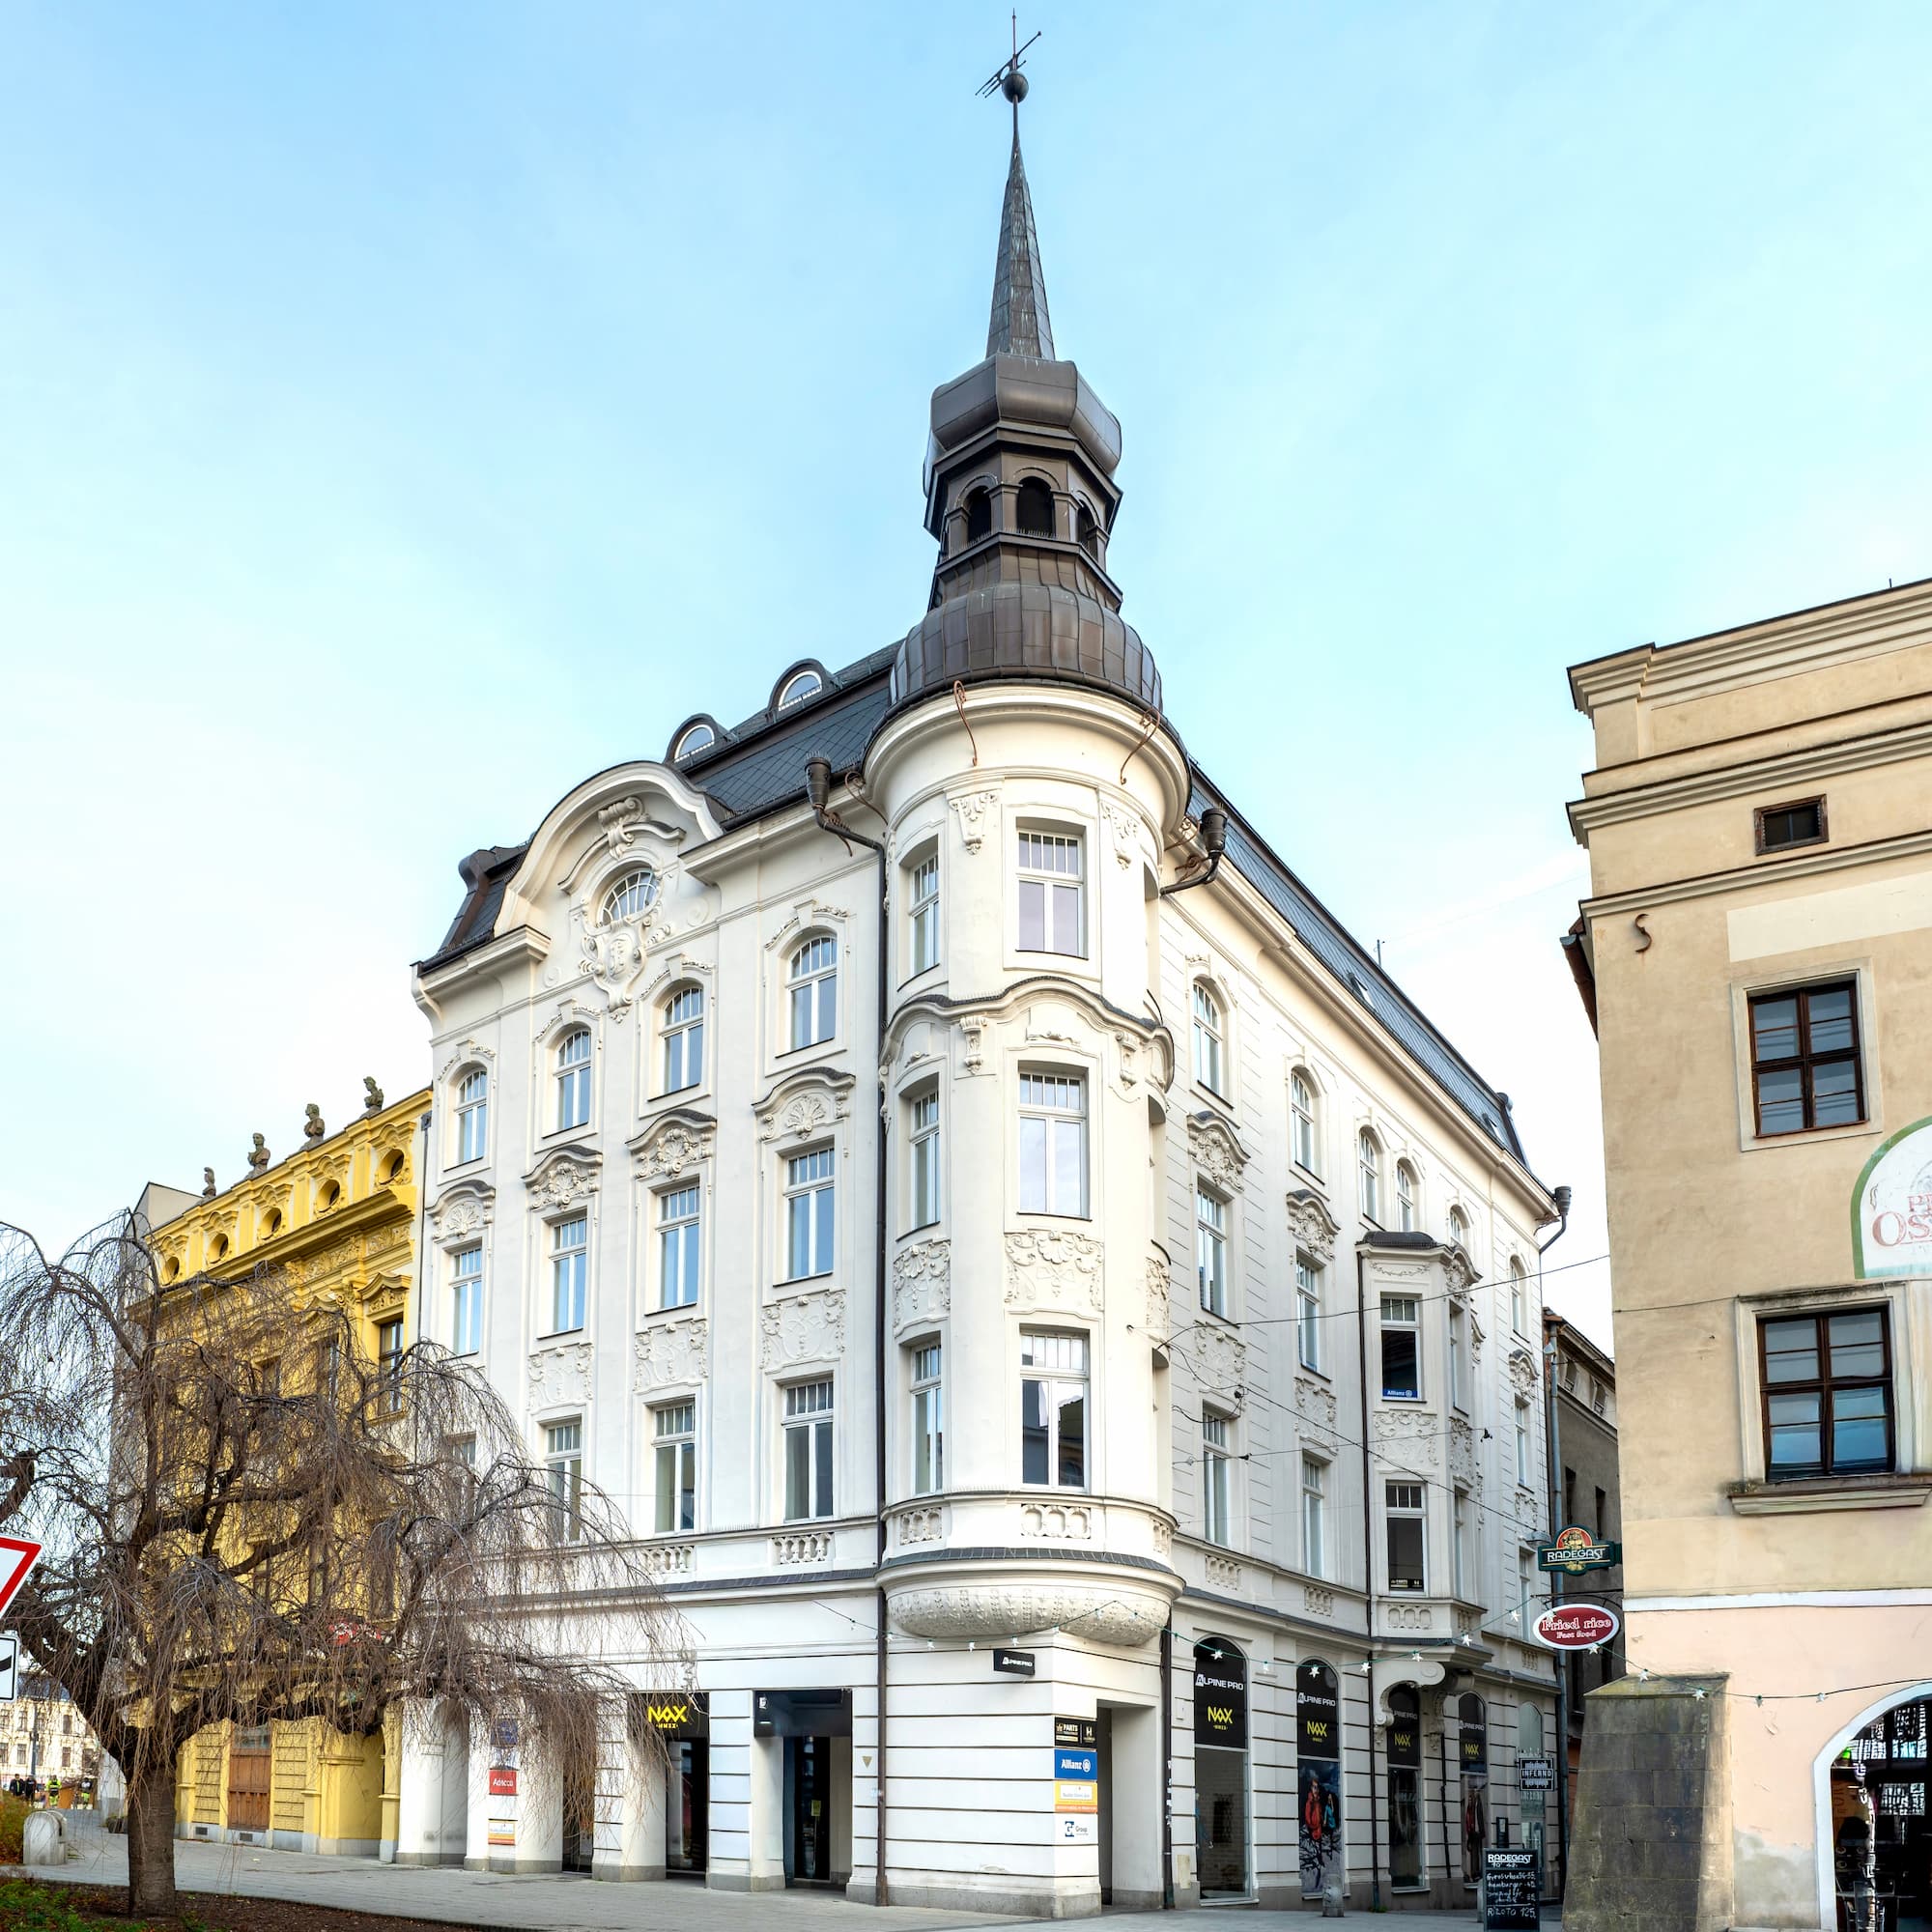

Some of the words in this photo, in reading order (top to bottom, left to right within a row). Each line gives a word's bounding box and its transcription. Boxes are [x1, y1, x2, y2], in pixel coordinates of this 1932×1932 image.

[1547, 1548, 1605, 1563] RADEGAST
[1542, 1616, 1580, 1632] Fried
[1583, 1616, 1612, 1630] rice
[1556, 1631, 1576, 1639] Fast
[1195, 1673, 1227, 1688] ALPINE
[1227, 1681, 1244, 1690] PRO
[1297, 1691, 1322, 1705] ALPINE
[1322, 1698, 1336, 1707] PRO
[648, 1705, 687, 1723] NAX
[1208, 1705, 1234, 1724] NAX
[1307, 1719, 1328, 1737] NAX
[1061, 1758, 1083, 1770] Allianz
[1488, 1854, 1533, 1863] RADEGAST
